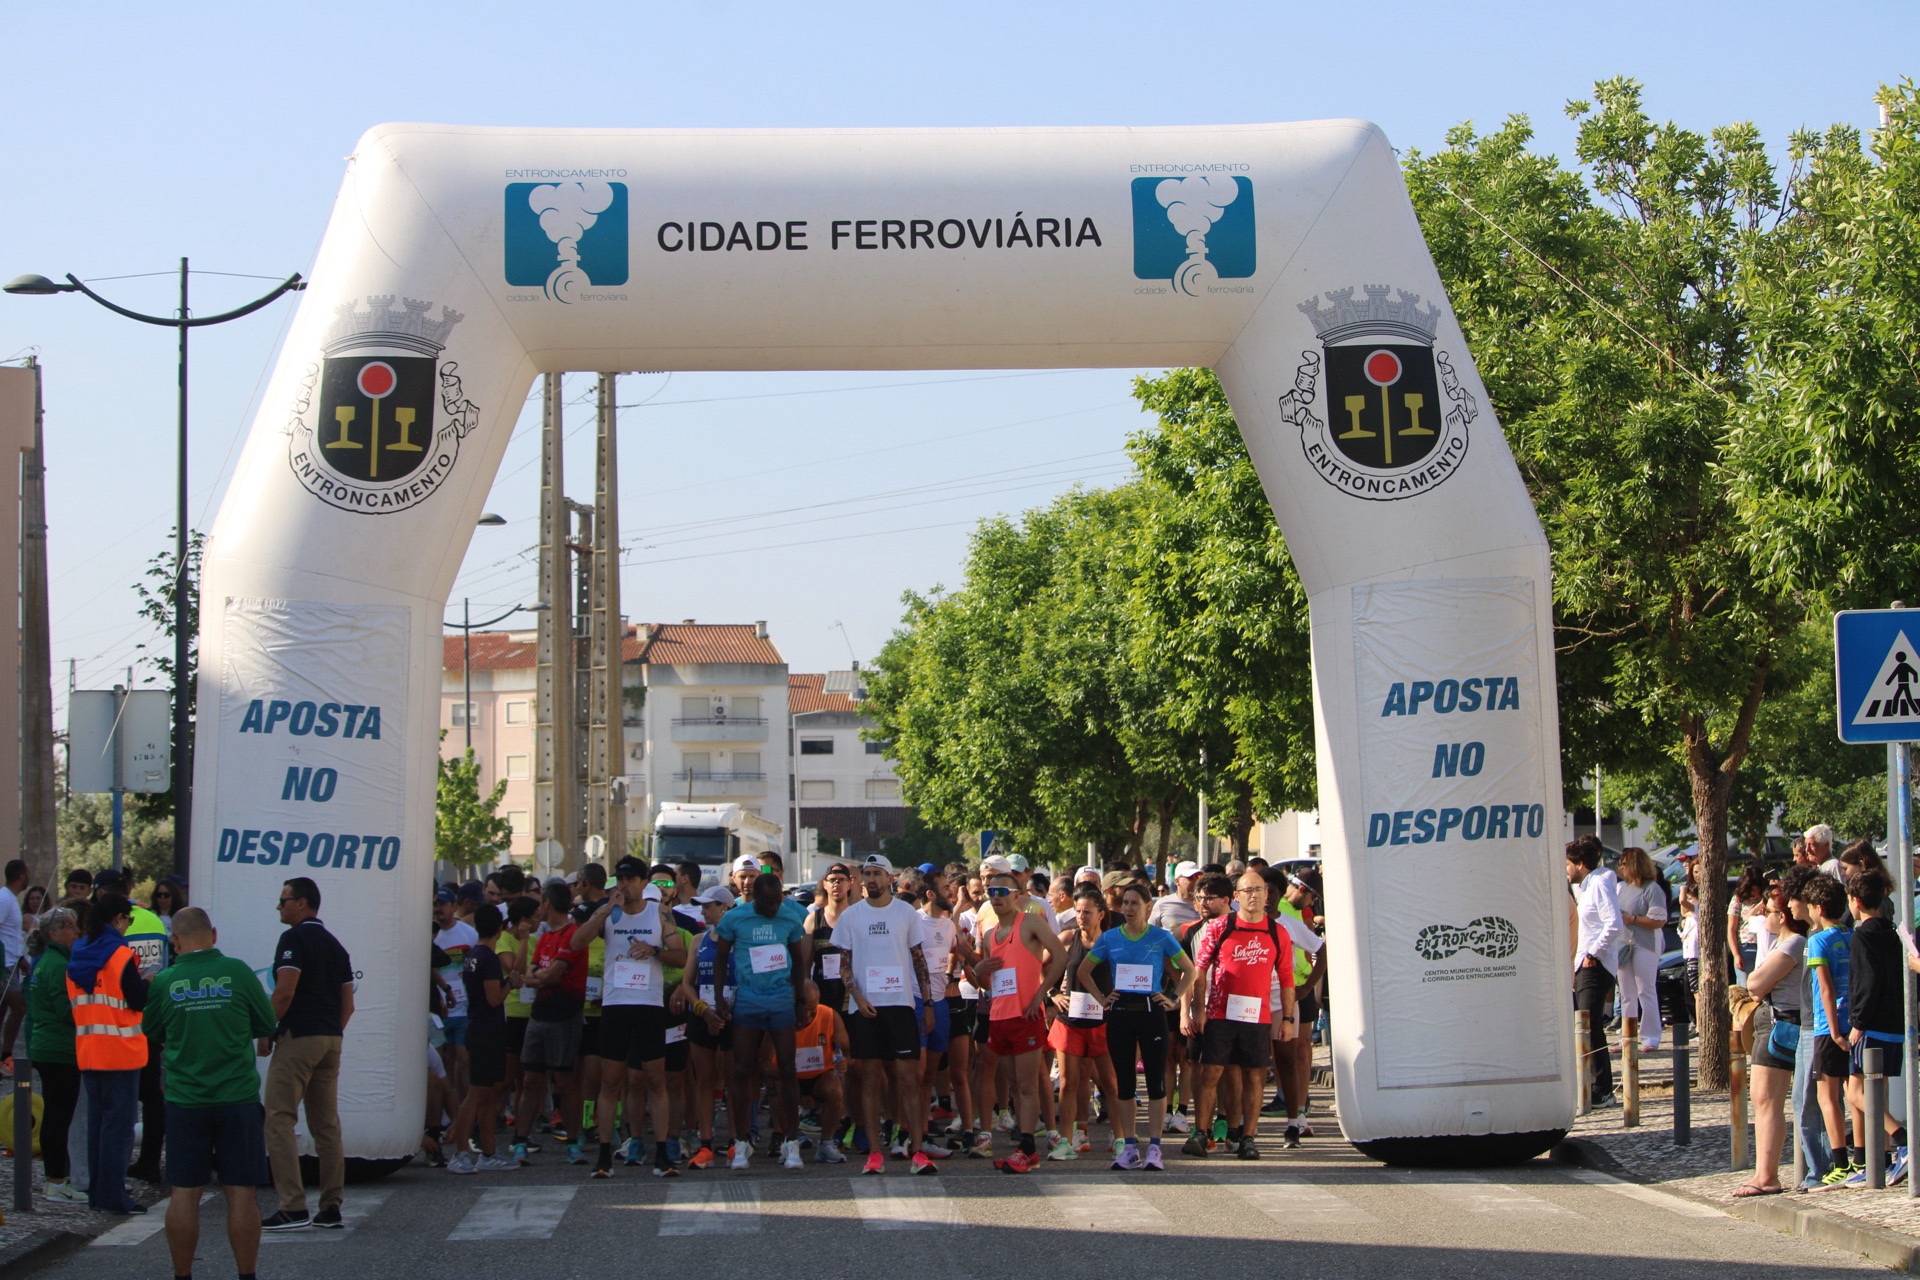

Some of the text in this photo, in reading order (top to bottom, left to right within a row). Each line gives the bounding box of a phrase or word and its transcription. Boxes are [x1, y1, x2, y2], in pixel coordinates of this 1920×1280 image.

[1130, 163, 1250, 173] ENTRONCAMENTO
[505, 169, 628, 178] ENTRONCAMENTO
[657, 211, 1102, 252] CIDADE FERROVIÁRIA
[1133, 286, 1167, 295] cidade
[506, 293, 540, 302] cidade
[1308, 436, 1464, 494] ENTRONCAMENTO
[294, 452, 451, 508] ENTRONCAMENTO
[1381, 676, 1520, 718] APOSTA
[239, 699, 381, 740] APOSTA
[1431, 741, 1486, 778] NO
[281, 766, 338, 802] NO
[1367, 803, 1544, 848] DESPORTO
[217, 828, 400, 871] DESPORTO
[1415, 930, 1519, 951] ENTRONCAMENTO
[770, 954, 783, 962] 460
[1424, 969, 1449, 977] CENTRO
[1450, 966, 1483, 974] MUNICIPAL
[1466, 971, 1517, 980] ENTRONCAMENTO
[632, 974, 646, 982] 477
[885, 977, 900, 985] 364
[1001, 978, 1013, 987] 358
[1134, 975, 1149, 983] 506
[1244, 1006, 1257, 1015] 462
